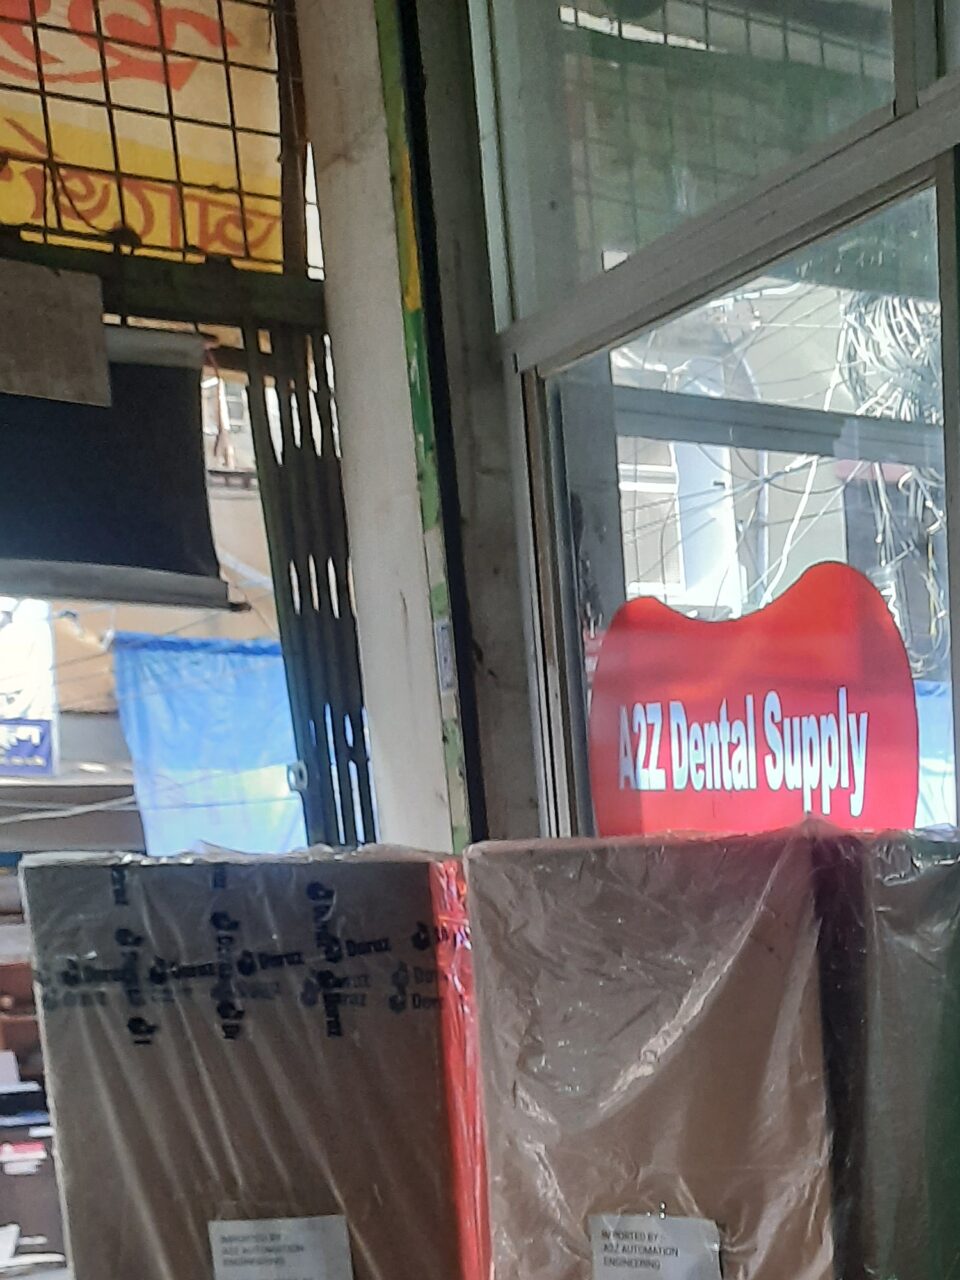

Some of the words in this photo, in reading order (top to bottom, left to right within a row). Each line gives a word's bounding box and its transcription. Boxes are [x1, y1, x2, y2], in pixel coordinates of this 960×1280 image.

[619, 702, 666, 791] A2Z
[669, 694, 757, 792] Dental
[764, 685, 868, 817] Supply
[622, 1245, 679, 1258] AUTOMATION
